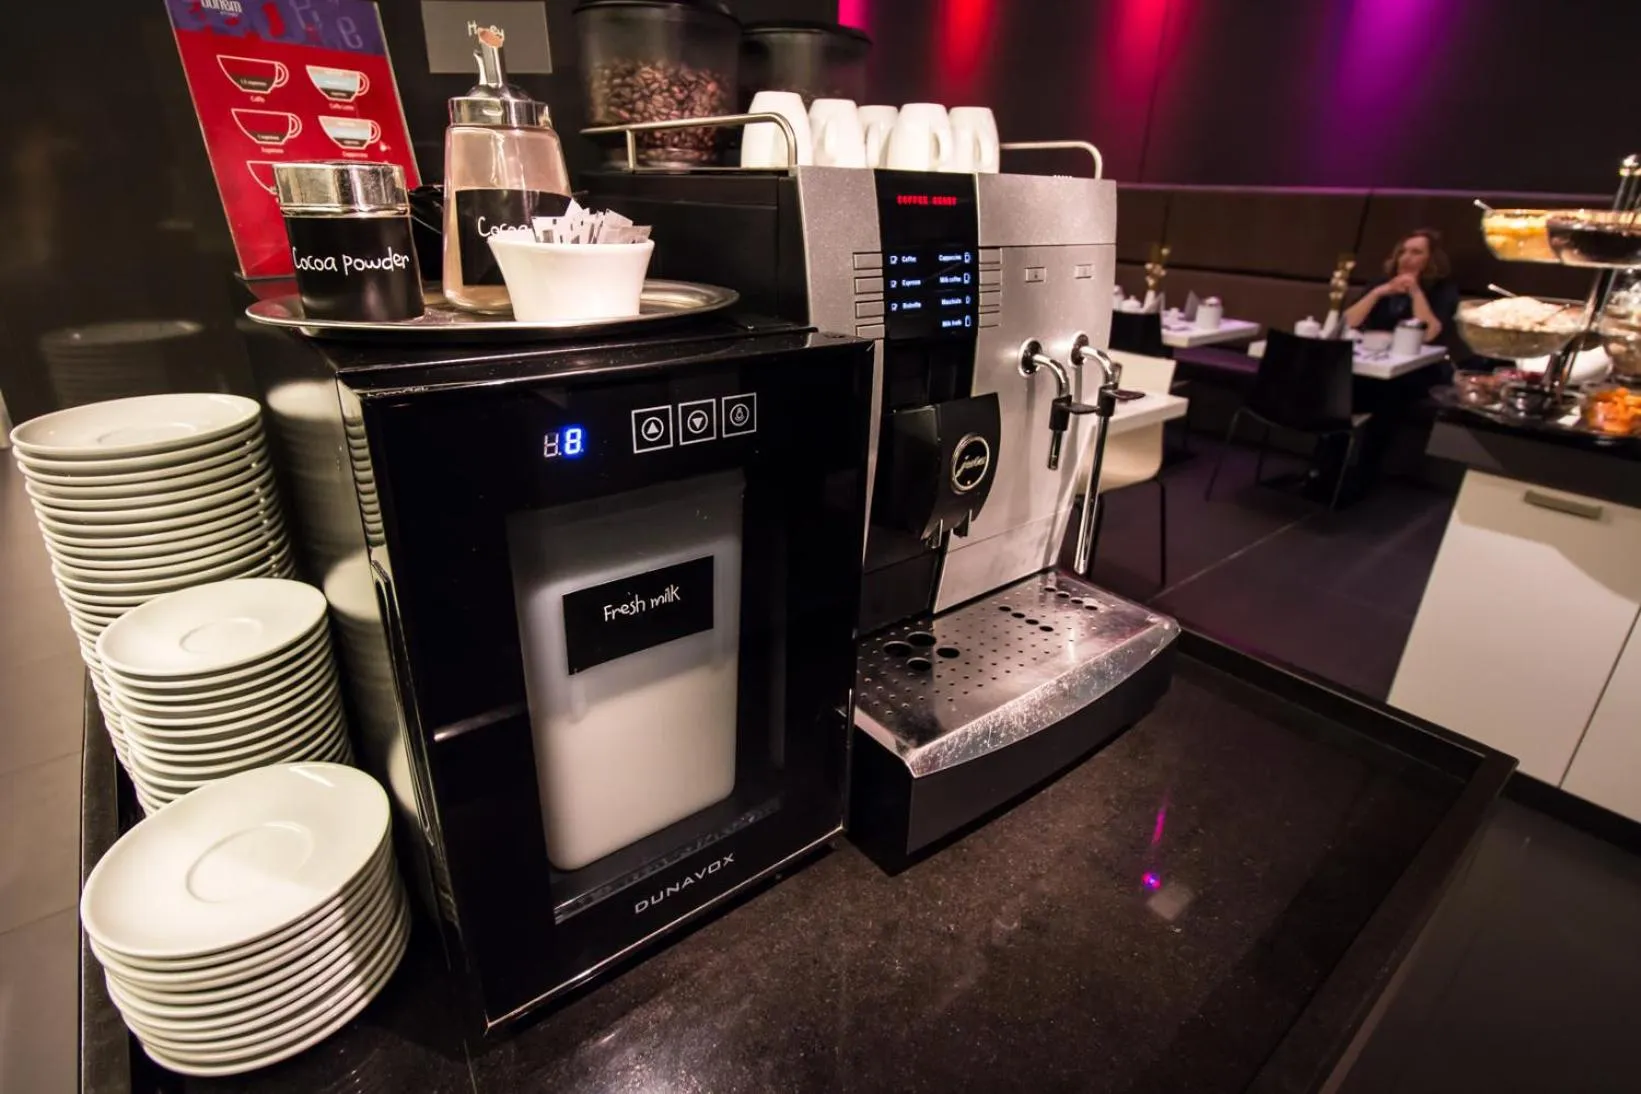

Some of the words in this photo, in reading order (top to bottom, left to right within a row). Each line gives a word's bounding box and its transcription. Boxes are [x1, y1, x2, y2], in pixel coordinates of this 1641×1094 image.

[292, 246, 338, 272] Cocoa
[342, 246, 410, 276] powder
[603, 593, 646, 622] Fresh
[650, 584, 681, 609] milk
[634, 852, 736, 915] DUNAVOX
